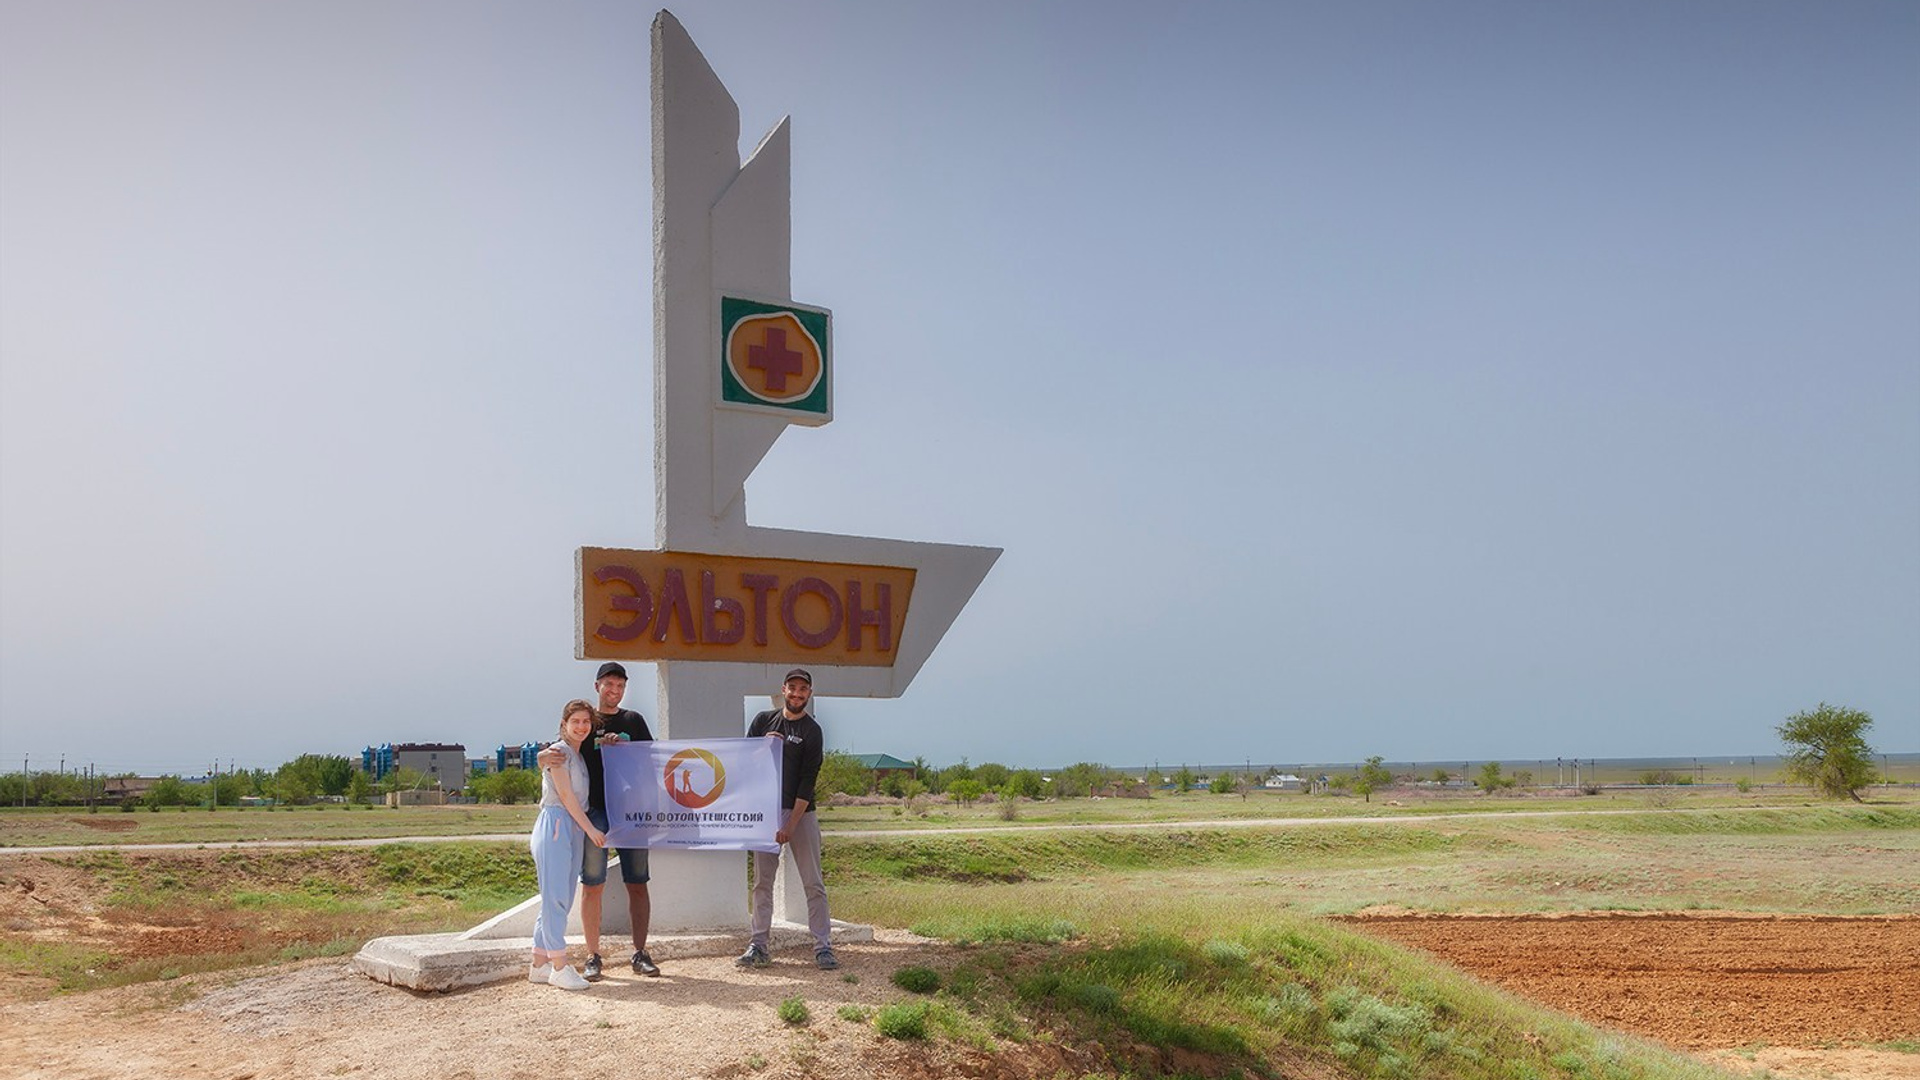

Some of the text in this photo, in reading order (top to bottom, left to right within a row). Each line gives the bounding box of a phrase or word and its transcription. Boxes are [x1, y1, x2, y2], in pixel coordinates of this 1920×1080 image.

[593, 565, 891, 651] ЭЛЬТОН
[625, 812, 763, 822] КЛУБ ФОТОПУТЕШЕСТВИЙ
